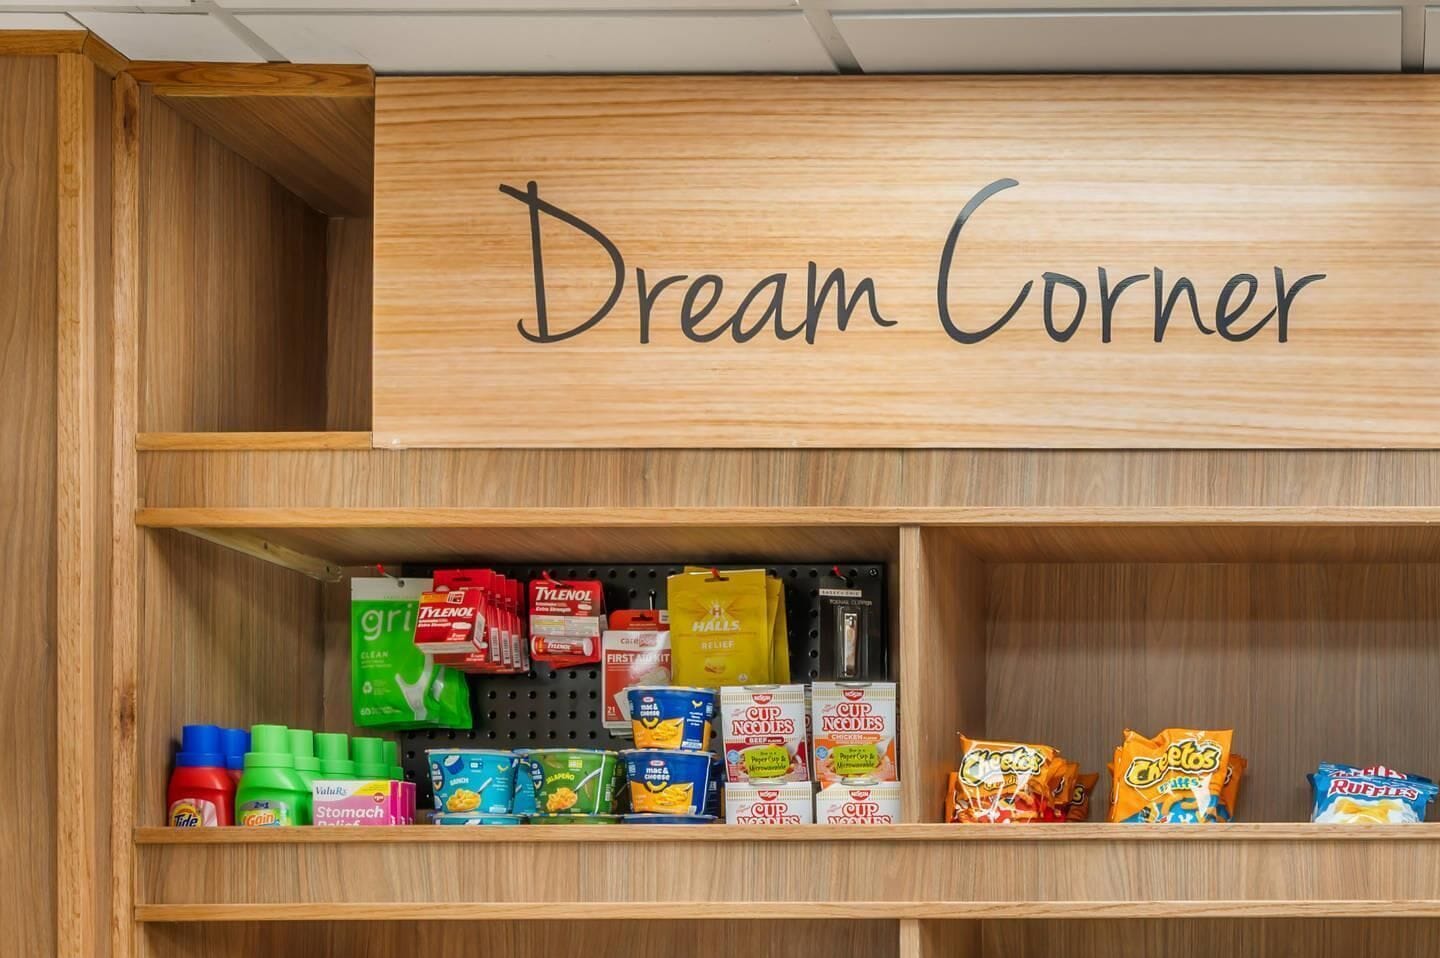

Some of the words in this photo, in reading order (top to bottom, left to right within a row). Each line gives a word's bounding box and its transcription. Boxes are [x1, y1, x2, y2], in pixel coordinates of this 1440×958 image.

[499, 180, 897, 344] Dream
[937, 177, 1326, 344] Corner
[535, 586, 593, 601] TYLENOL
[419, 606, 476, 619] TYLENOL
[361, 604, 412, 641] gri
[692, 620, 741, 632] HALLS
[701, 640, 735, 650] RELIEF
[607, 653, 635, 663] FIRST
[746, 706, 782, 720] CUP
[836, 702, 873, 717] CUP
[731, 719, 795, 736] NOODLES
[822, 716, 885, 732] NOODLES
[831, 733, 863, 741] CHICKEN
[1126, 741, 1219, 787] Cheetos
[1328, 779, 1418, 800] RUFFLES
[316, 805, 385, 818] Stomach
[751, 803, 788, 817] CUP
[842, 803, 880, 817] CUP
[175, 813, 199, 827] Tide
[244, 813, 276, 827] Gain
